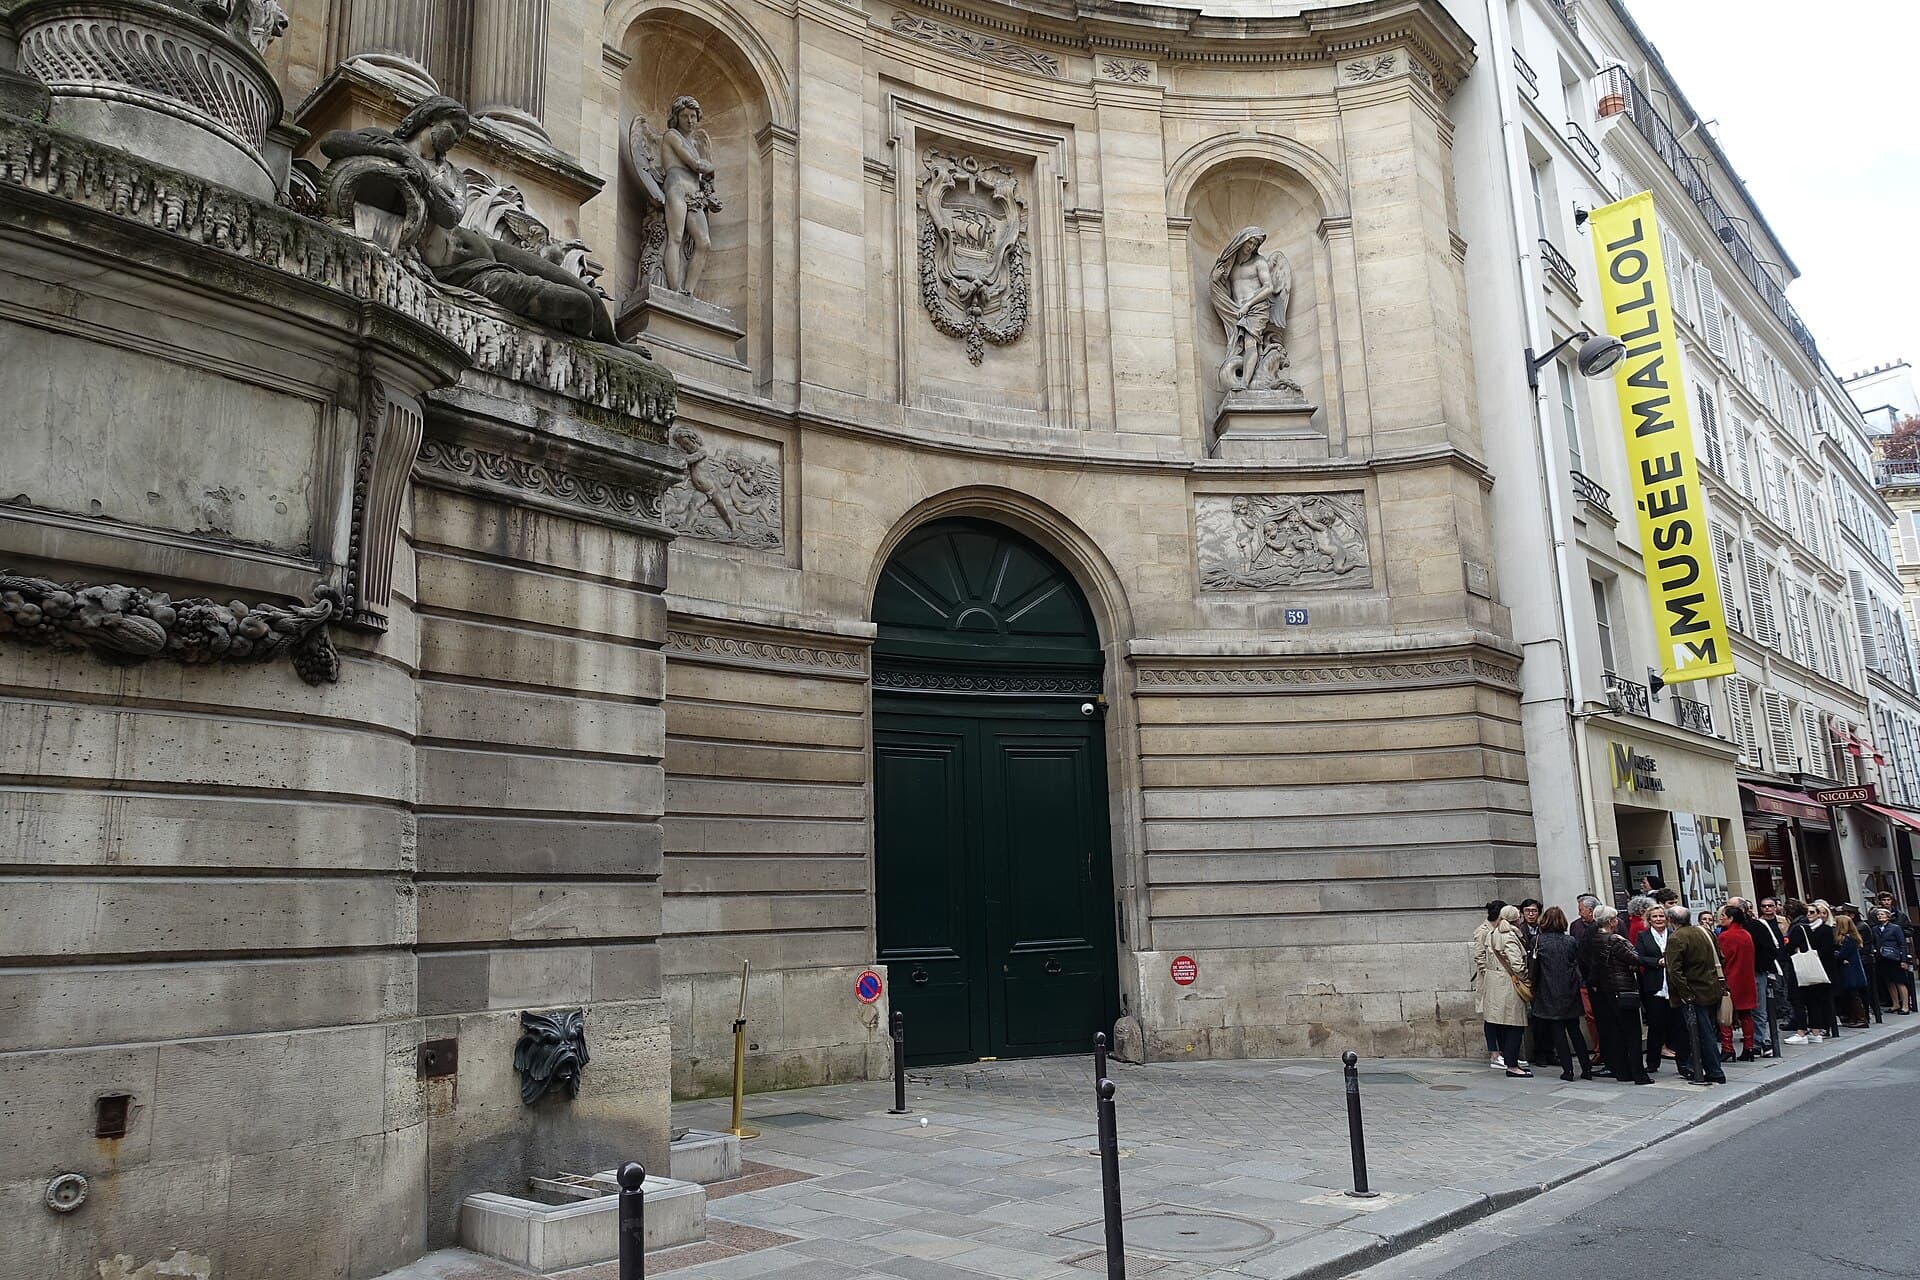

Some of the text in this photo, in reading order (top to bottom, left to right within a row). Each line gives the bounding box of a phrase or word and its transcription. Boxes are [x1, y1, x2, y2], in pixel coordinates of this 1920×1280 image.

[1606, 217, 1710, 637] MUSÉE MAILLOL
[1288, 611, 1304, 623] 59
[1820, 790, 1865, 802] NICOLAS
